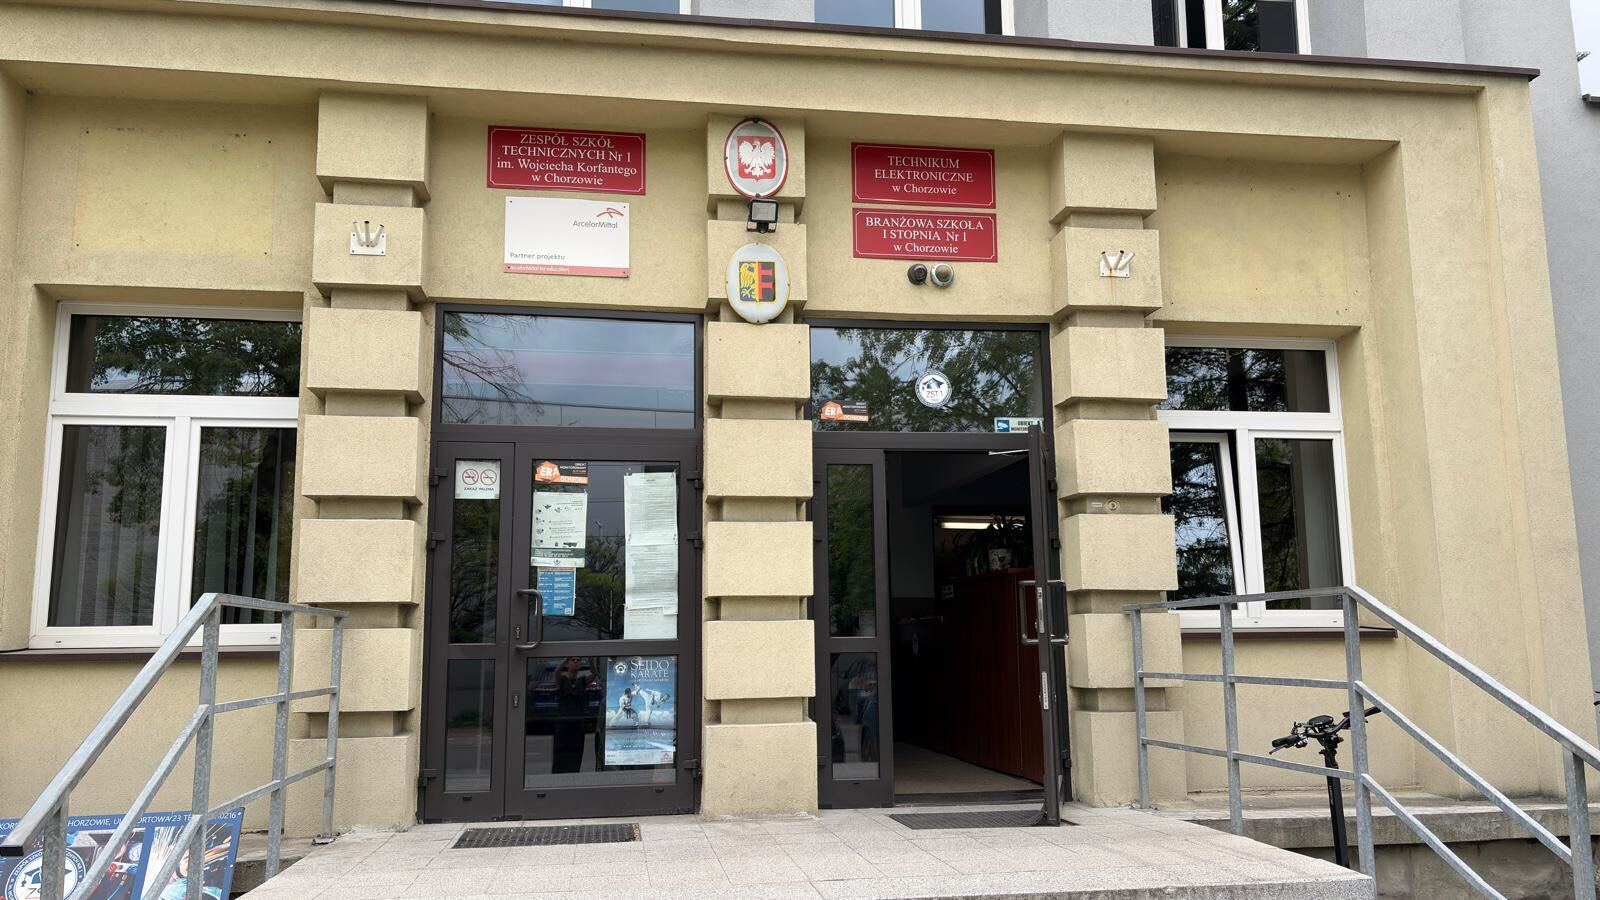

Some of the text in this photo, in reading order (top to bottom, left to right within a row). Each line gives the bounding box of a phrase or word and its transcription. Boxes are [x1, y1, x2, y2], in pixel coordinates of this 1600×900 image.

[520, 133, 615, 148] ZESPÓŁ SZKÓŁ
[501, 145, 631, 162] TECHNICZNYCH Nr 1
[496, 157, 638, 177] im. Wojciecha Korfantego
[888, 155, 960, 168] TECHNIKUM
[531, 172, 604, 185] w Chorzowie
[874, 168, 974, 183] ELEKTRONICZNE
[892, 183, 957, 195] w Chorzowie
[572, 219, 618, 229] ArcelorMittal
[865, 216, 984, 231] BRANŻOWA SZKOŁA
[882, 229, 967, 242] I STOPNIA Nr 1
[893, 243, 959, 254] w Chorzowie
[536, 253, 566, 261] projektu
[825, 406, 843, 417] ERA
[540, 467, 560, 478] ERA
[630, 659, 670, 671] SEIDO
[630, 670, 669, 678] KARATE
